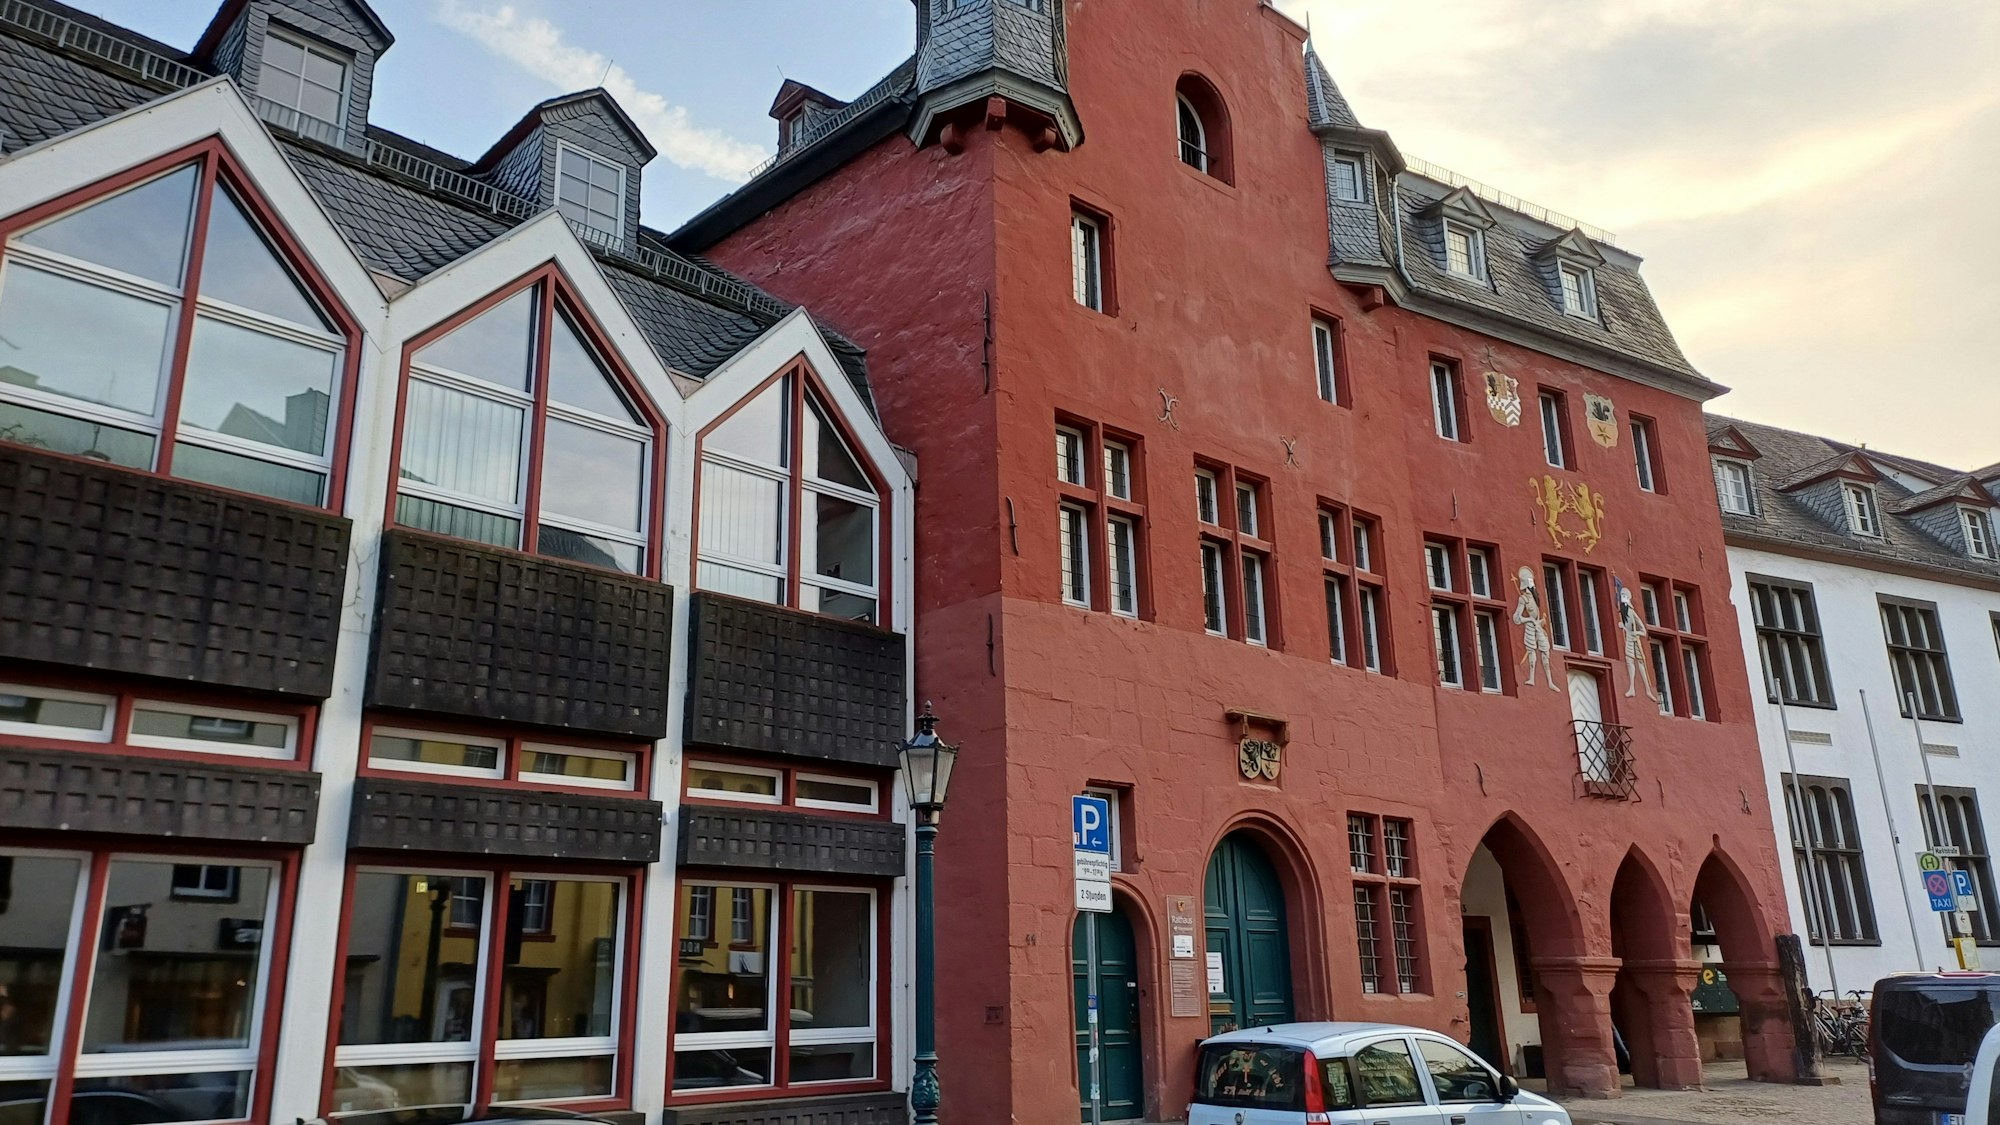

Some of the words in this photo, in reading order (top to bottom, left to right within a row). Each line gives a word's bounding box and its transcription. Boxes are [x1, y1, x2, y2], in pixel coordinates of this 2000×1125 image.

[1081, 804, 1100, 845] P
[1925, 858, 1935, 868] H
[1955, 874, 1966, 895] P
[1081, 889, 1085, 899] 2
[1085, 890, 1107, 901] Stunden
[1931, 898, 1952, 908] TAXI
[1171, 916, 1193, 925] Rathaus
